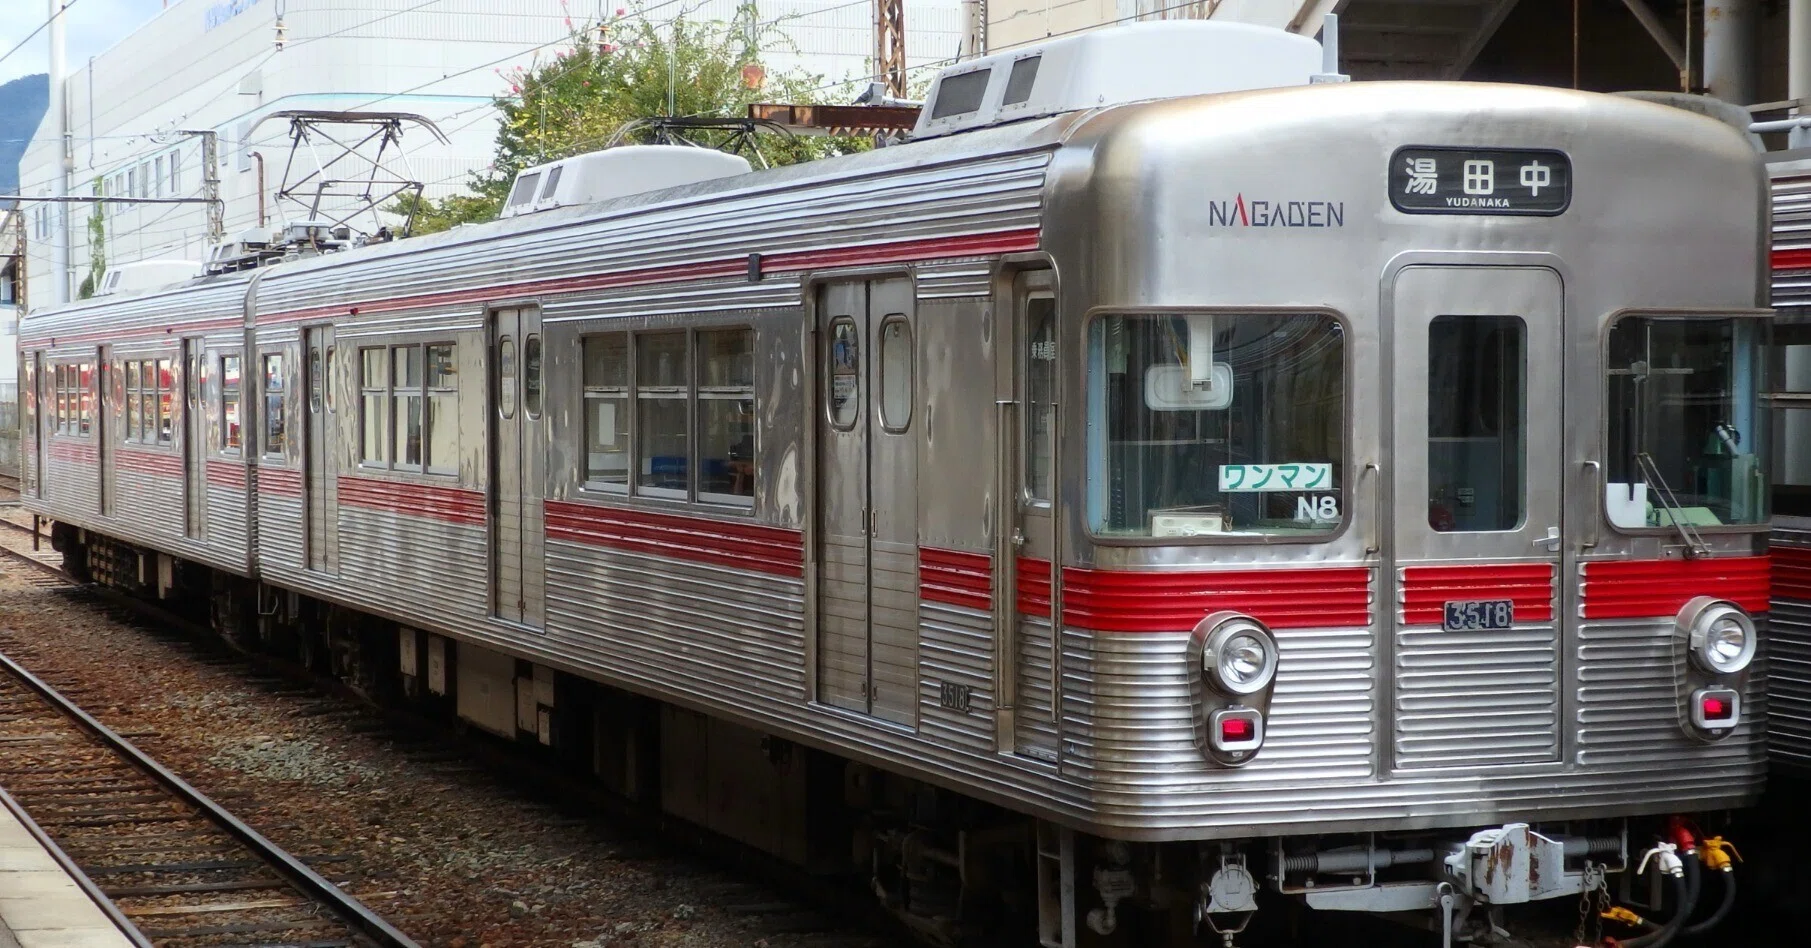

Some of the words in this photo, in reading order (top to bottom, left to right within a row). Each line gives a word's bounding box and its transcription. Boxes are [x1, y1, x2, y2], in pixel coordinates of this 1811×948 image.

[1404, 156, 1551, 198] 湯田中
[1209, 191, 1344, 227] NAGADEN
[1445, 197, 1510, 208] YUDANAKA
[1224, 465, 1326, 489] ワンマン
[1296, 495, 1338, 520] N8
[1449, 602, 1508, 630] 3518
